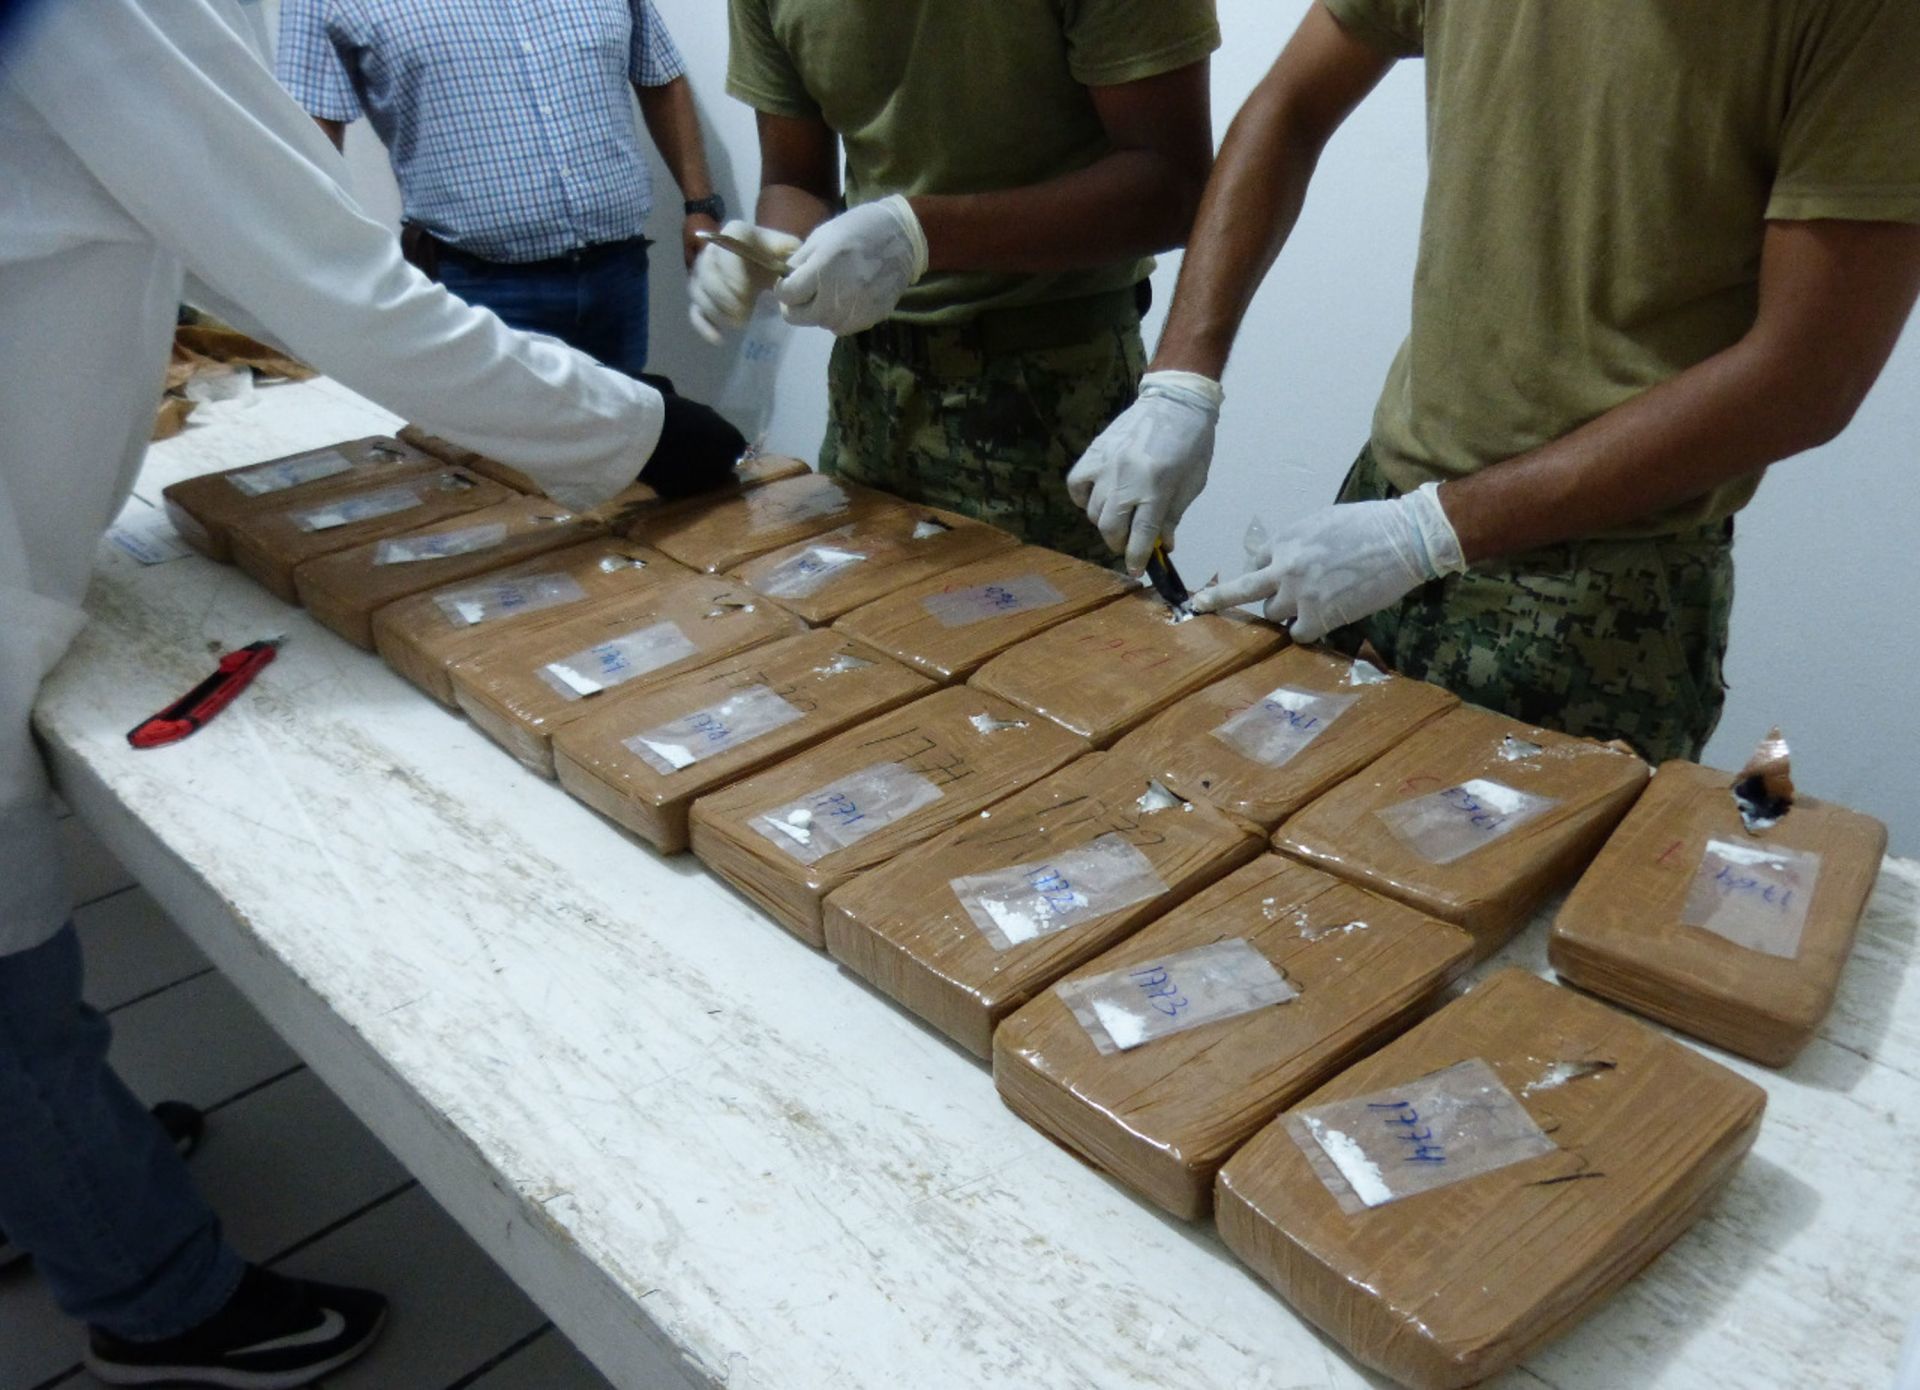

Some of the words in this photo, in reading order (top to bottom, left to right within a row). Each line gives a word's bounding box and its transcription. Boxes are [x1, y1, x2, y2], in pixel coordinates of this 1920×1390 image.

[810, 790, 865, 827] 1771
[1022, 864, 1076, 915] 1772
[1128, 965, 1189, 1018] 1773
[1367, 1100, 1448, 1166] 1774
